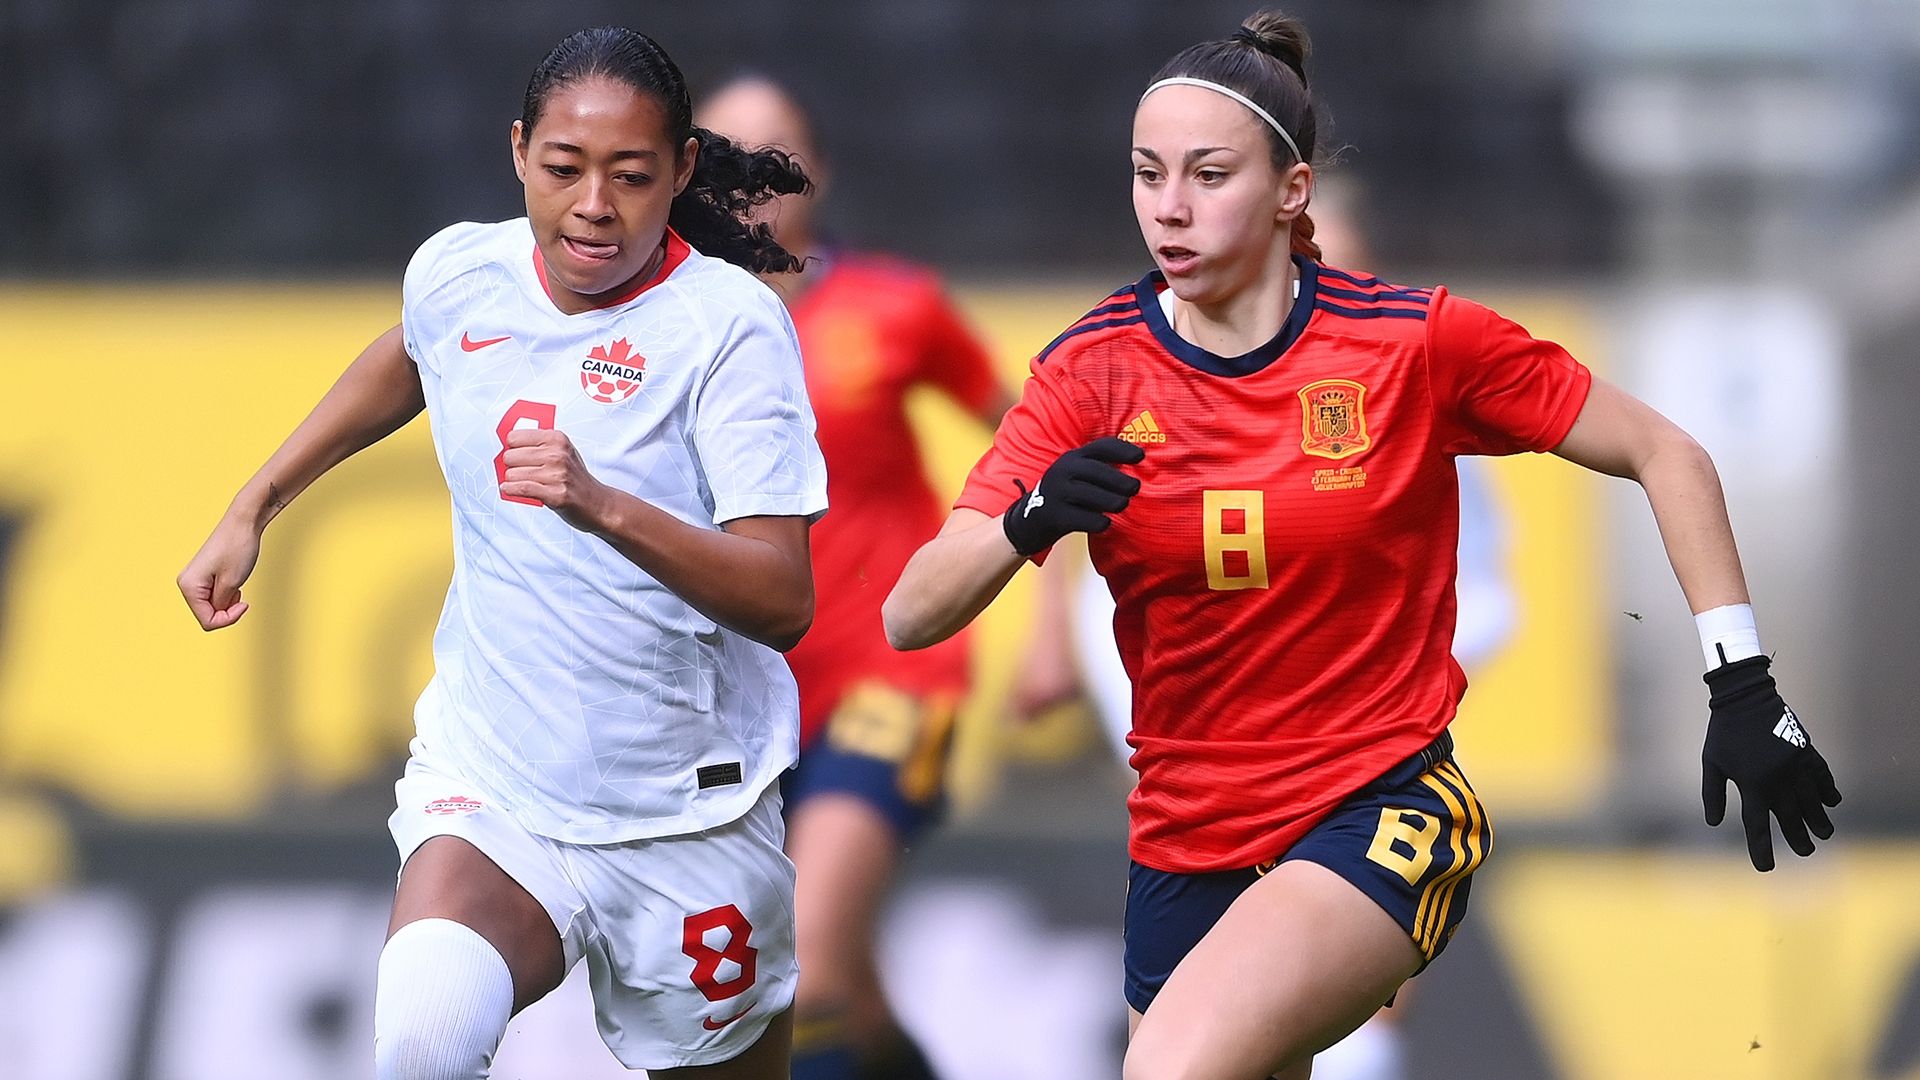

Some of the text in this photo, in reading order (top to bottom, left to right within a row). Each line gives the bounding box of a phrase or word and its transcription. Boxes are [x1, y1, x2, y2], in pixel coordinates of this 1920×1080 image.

[582, 360, 643, 382] CANADA
[1117, 431, 1166, 443] adidas
[1203, 489, 1269, 590] 8
[682, 903, 758, 1002] 8
